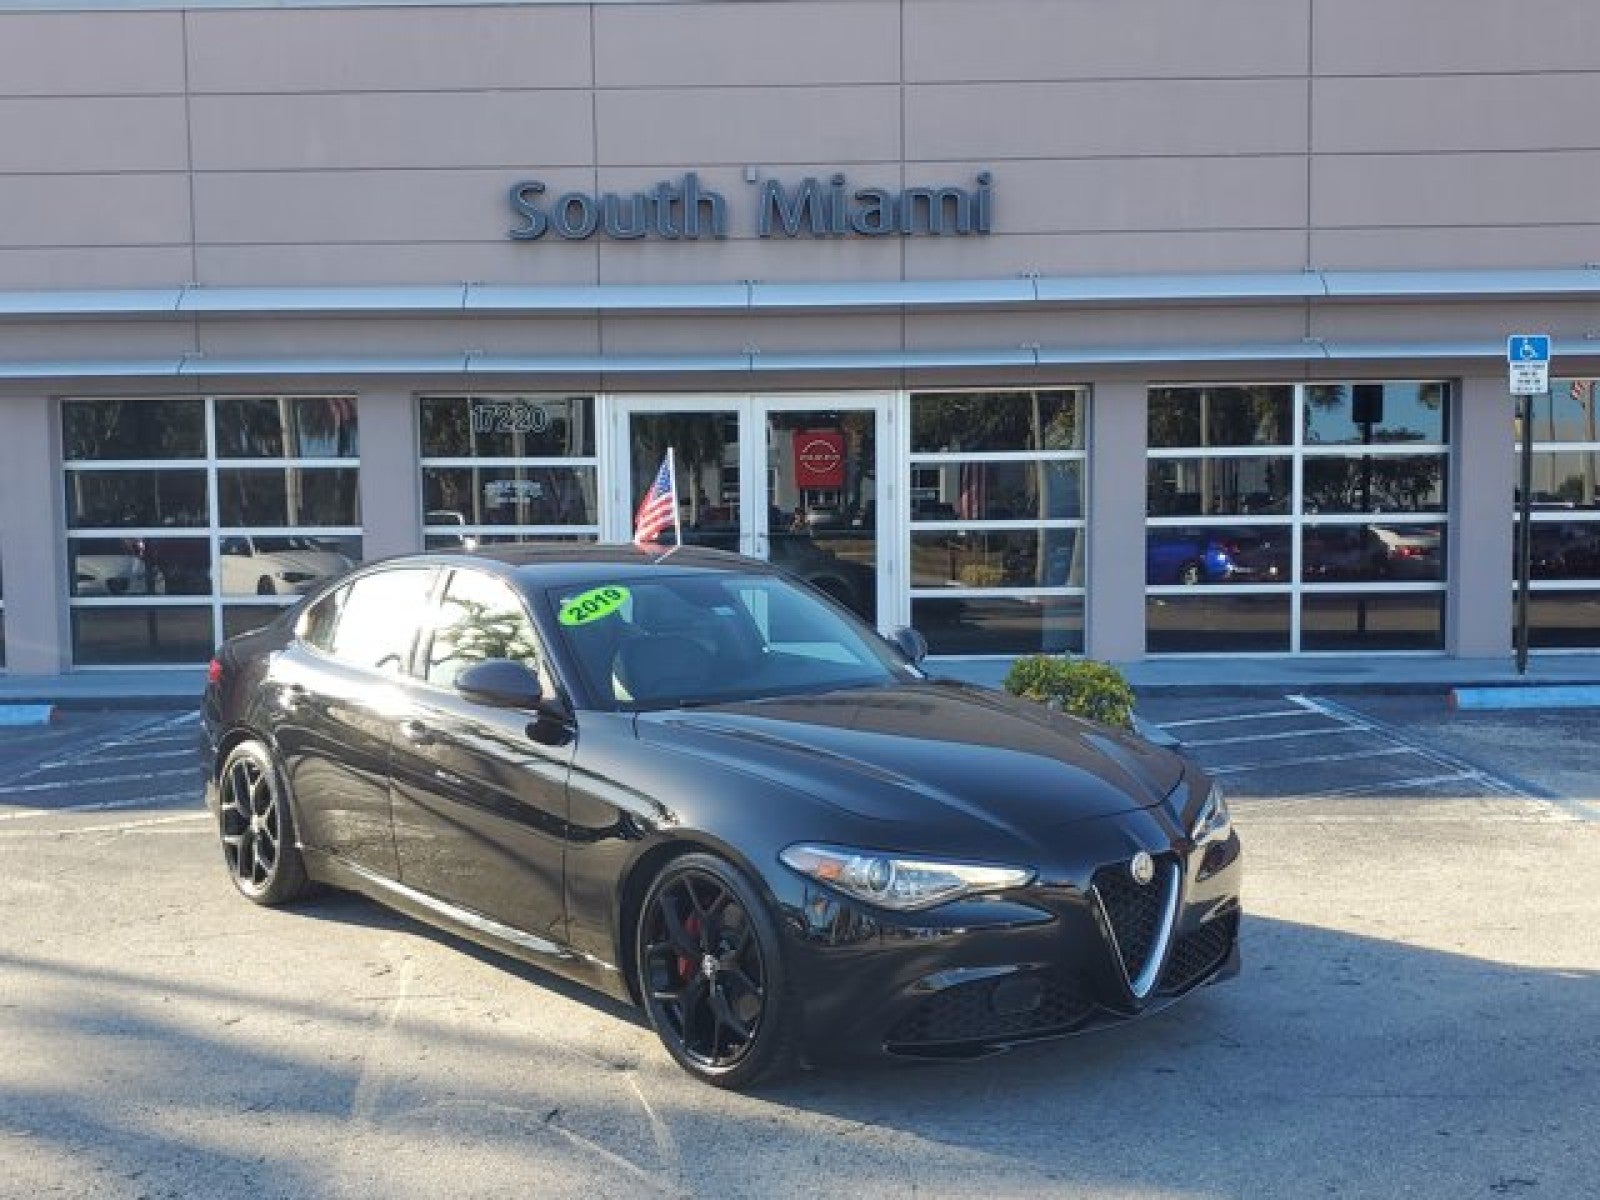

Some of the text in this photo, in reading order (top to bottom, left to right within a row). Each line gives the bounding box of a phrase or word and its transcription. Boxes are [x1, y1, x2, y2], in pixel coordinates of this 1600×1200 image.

[508, 171, 992, 240] South Miami
[473, 404, 548, 433] 17220
[567, 589, 621, 621] 2019
